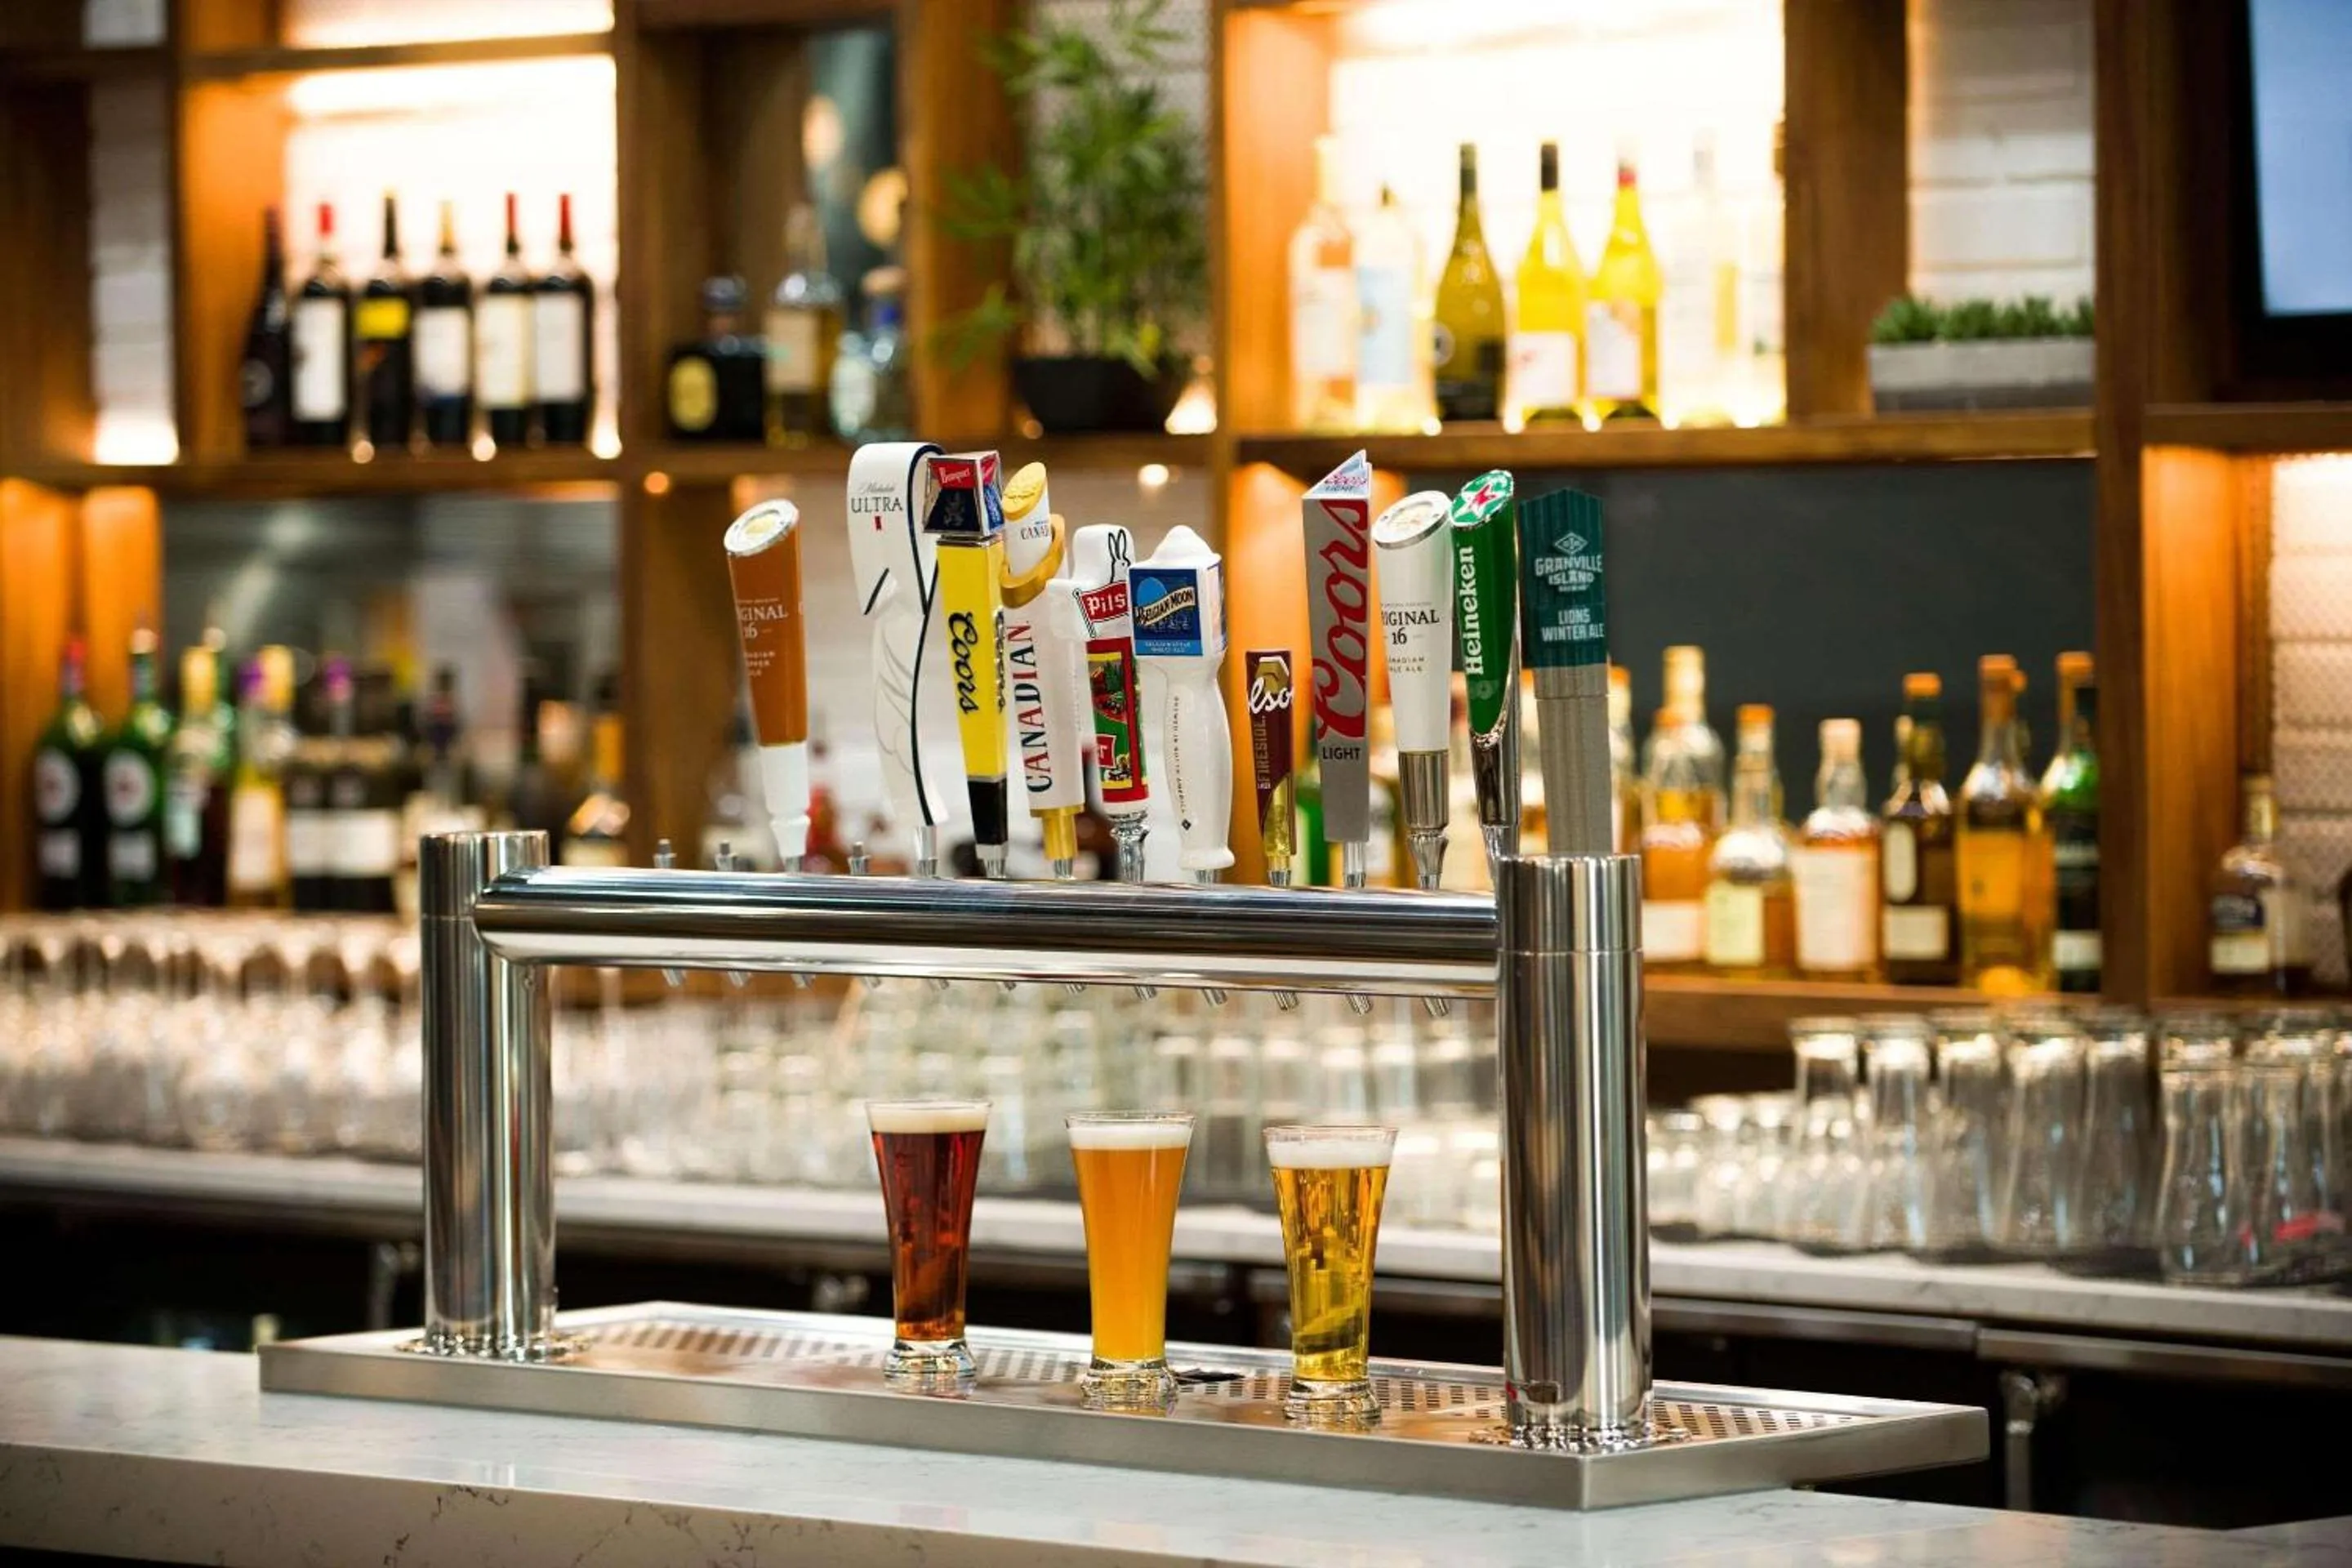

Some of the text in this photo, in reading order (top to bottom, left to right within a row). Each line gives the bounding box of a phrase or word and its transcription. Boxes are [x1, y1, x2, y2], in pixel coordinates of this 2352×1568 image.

[851, 497, 903, 514] ULTRA
[1534, 555, 1604, 577] GRANVILLE
[1548, 571, 1595, 586] ISLAND
[1170, 590, 1194, 609] MOON
[739, 604, 789, 621] GINAL
[1312, 499, 1368, 740] Coors
[1459, 546, 1484, 676] Heineken
[1558, 608, 1592, 625] LIONS
[1392, 627, 1408, 645] 16
[1541, 623, 1605, 642] WINTER ALE
[948, 612, 979, 715] Coors
[1006, 624, 1054, 794] CANADIAN
[1322, 746, 1361, 761] LIGHT
